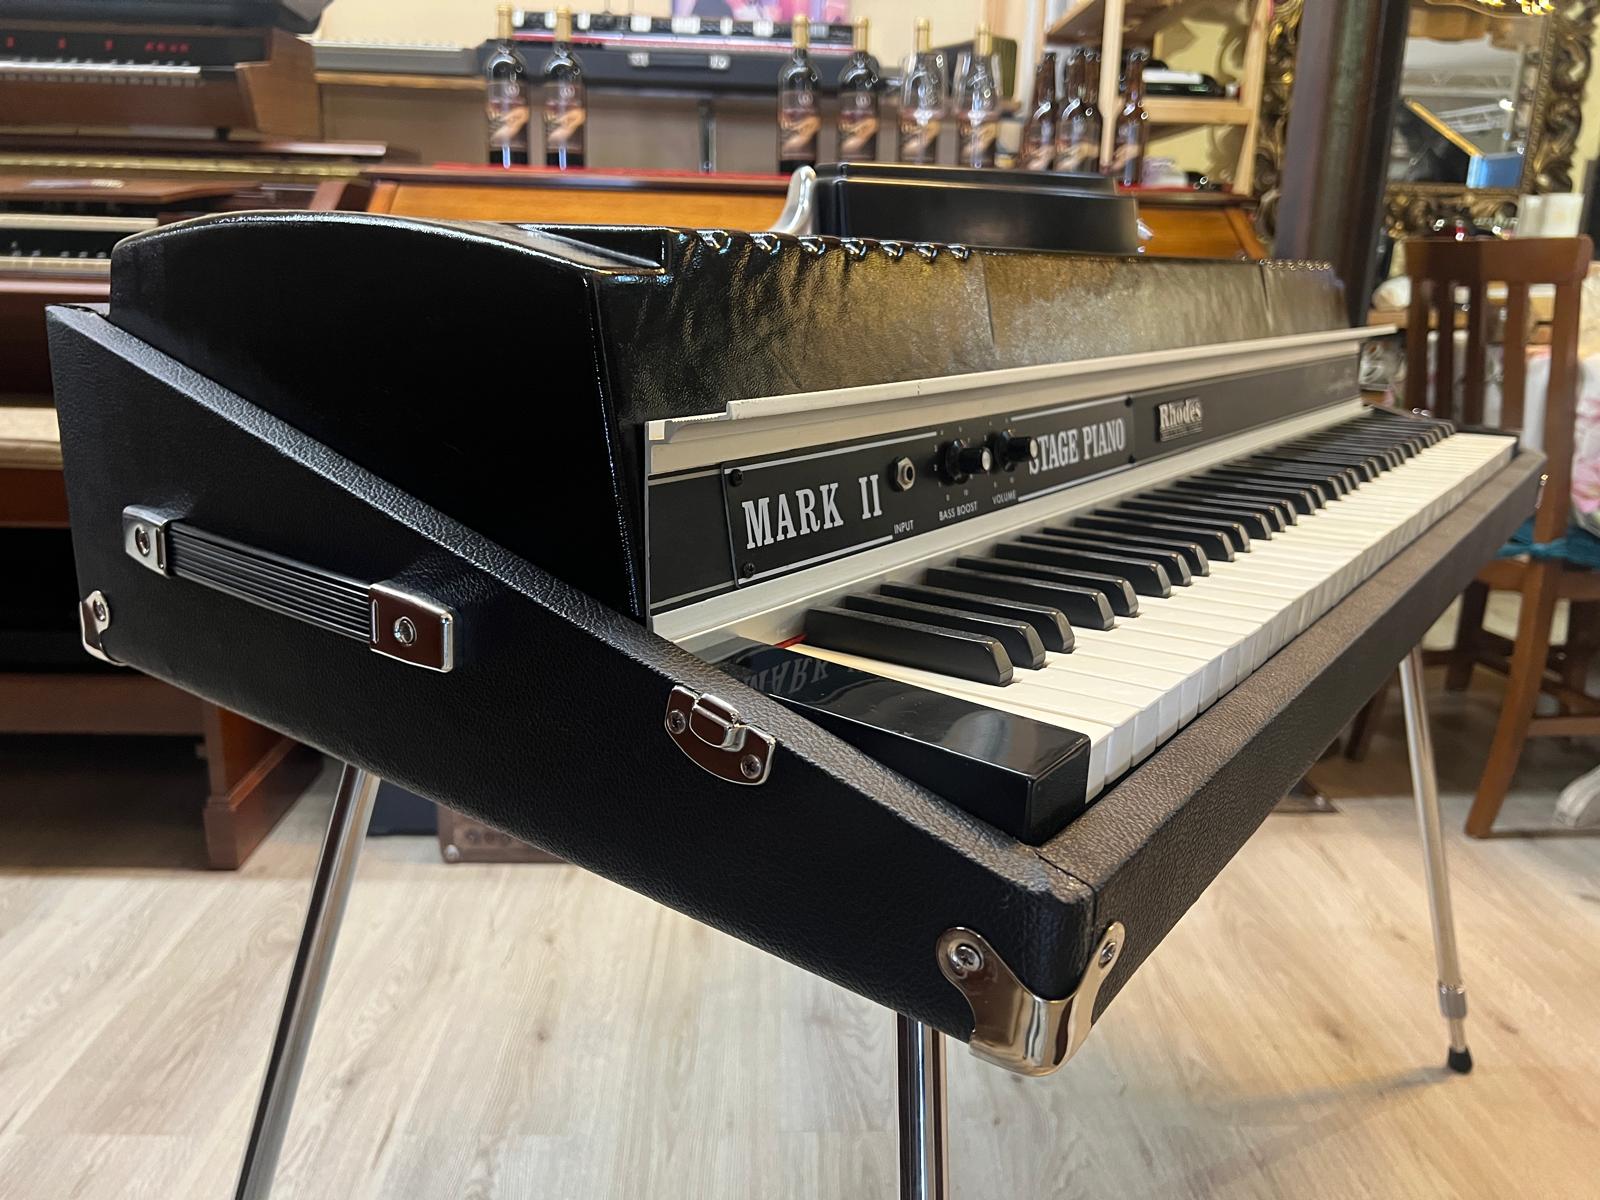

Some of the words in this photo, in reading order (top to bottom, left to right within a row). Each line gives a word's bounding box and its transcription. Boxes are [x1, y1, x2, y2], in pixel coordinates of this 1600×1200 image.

[1159, 399, 1202, 429] Rhodes
[1082, 418, 1127, 460] PIANO
[992, 489, 1016, 505] VOLUME
[741, 482, 844, 549] MARK
[858, 474, 882, 520] II
[939, 507, 955, 521] BASS
[956, 500, 978, 516] BOOST
[894, 519, 914, 535] INPUT
